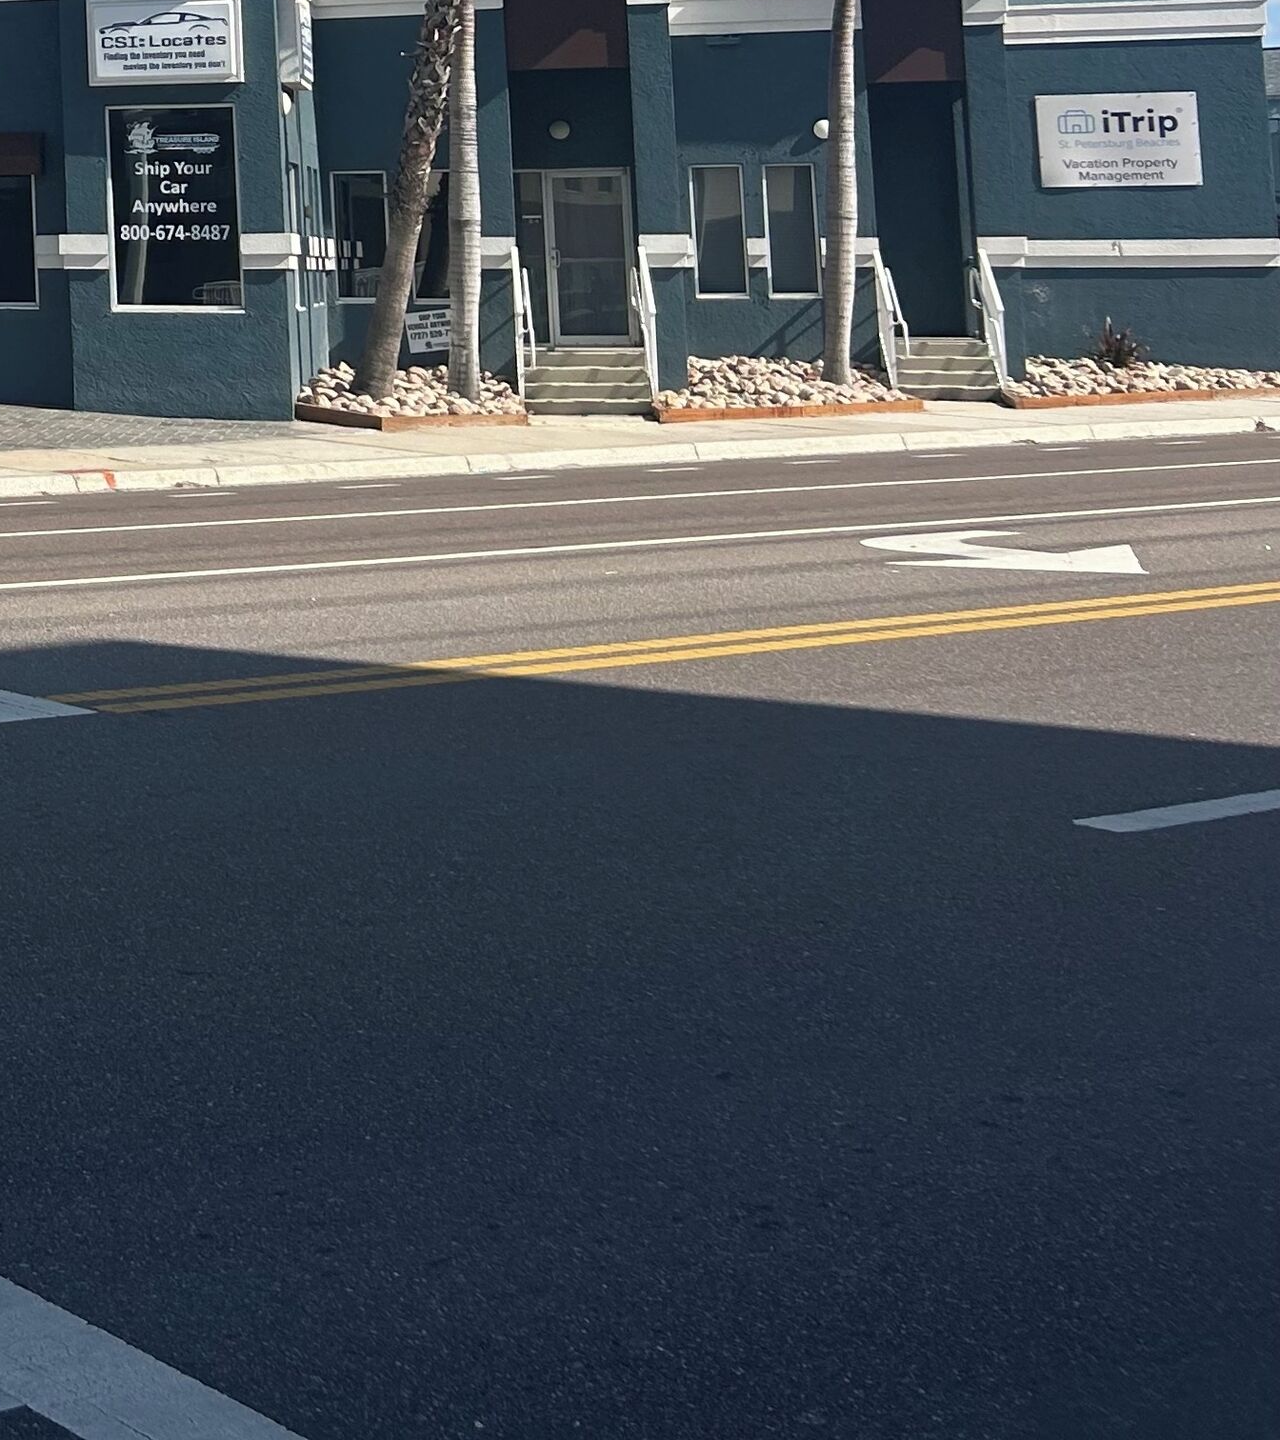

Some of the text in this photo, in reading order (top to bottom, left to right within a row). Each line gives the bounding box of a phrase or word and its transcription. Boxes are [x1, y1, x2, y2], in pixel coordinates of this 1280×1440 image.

[149, 34, 227, 48] Locates
[103, 52, 128, 61] Finding
[130, 52, 140, 60] the
[175, 51, 187, 59] you
[188, 49, 205, 58] need
[1101, 108, 1178, 138] iTrip
[1058, 138, 1180, 149] St. Petersburg Beaches
[134, 161, 213, 178] Ship Your
[1062, 158, 1178, 169] Vacation Property
[1079, 171, 1164, 182] Management
[160, 180, 189, 194] Car
[132, 199, 217, 216] Anywhere
[120, 224, 231, 241] 800-674-8487
[410, 331, 428, 340] (727)
